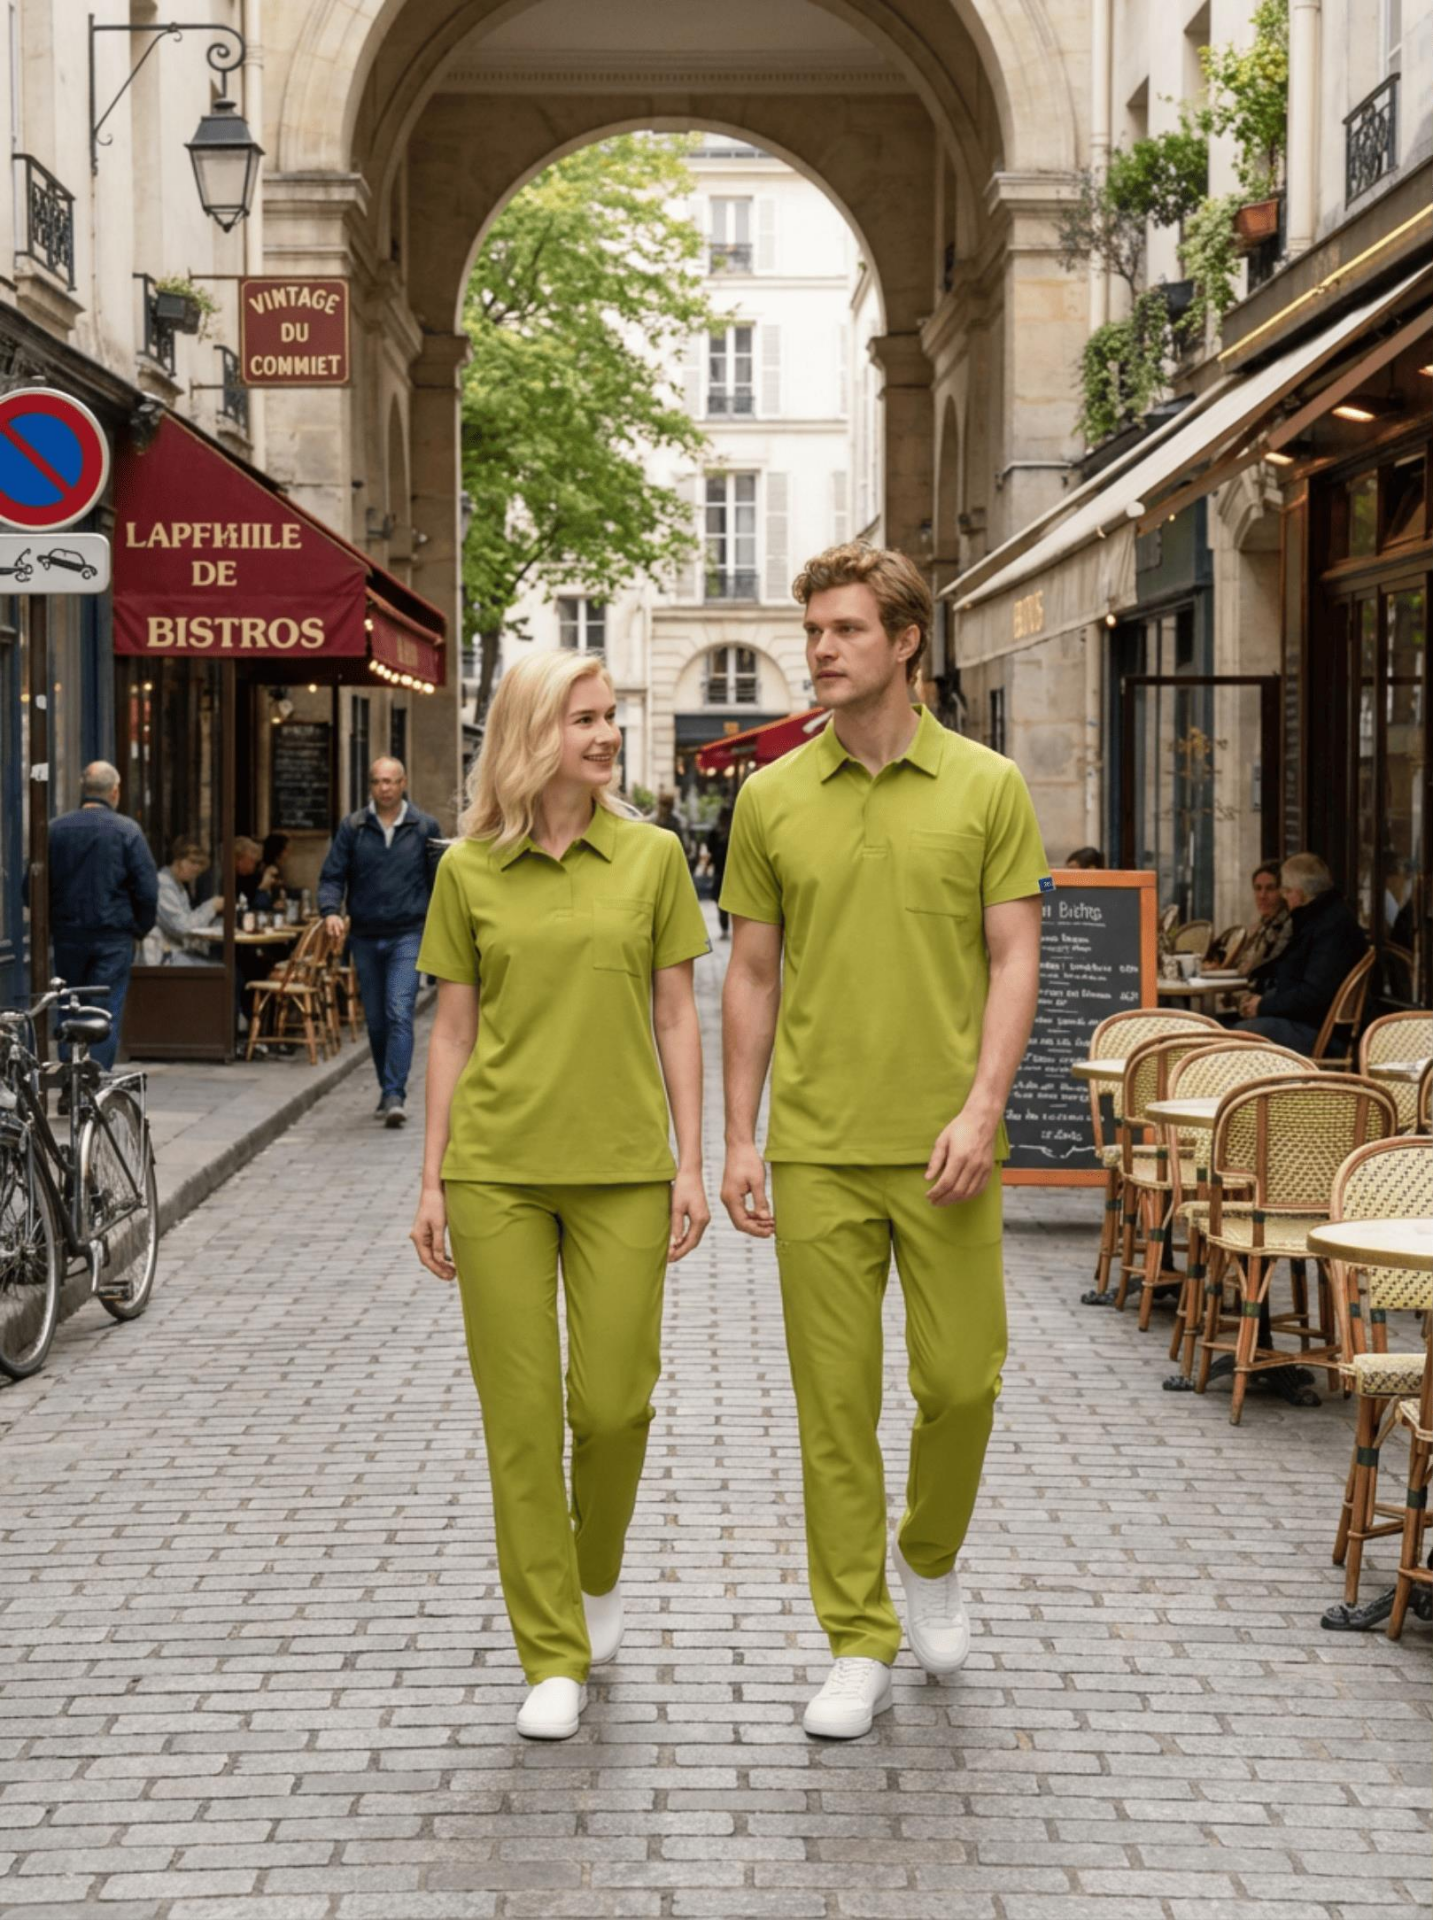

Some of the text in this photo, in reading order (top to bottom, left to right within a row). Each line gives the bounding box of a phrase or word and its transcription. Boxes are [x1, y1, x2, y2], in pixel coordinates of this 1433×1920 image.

[249, 286, 340, 315] VINTAGE
[281, 322, 309, 343] DU
[191, 560, 237, 586] DE
[147, 617, 325, 649] BISTROS
